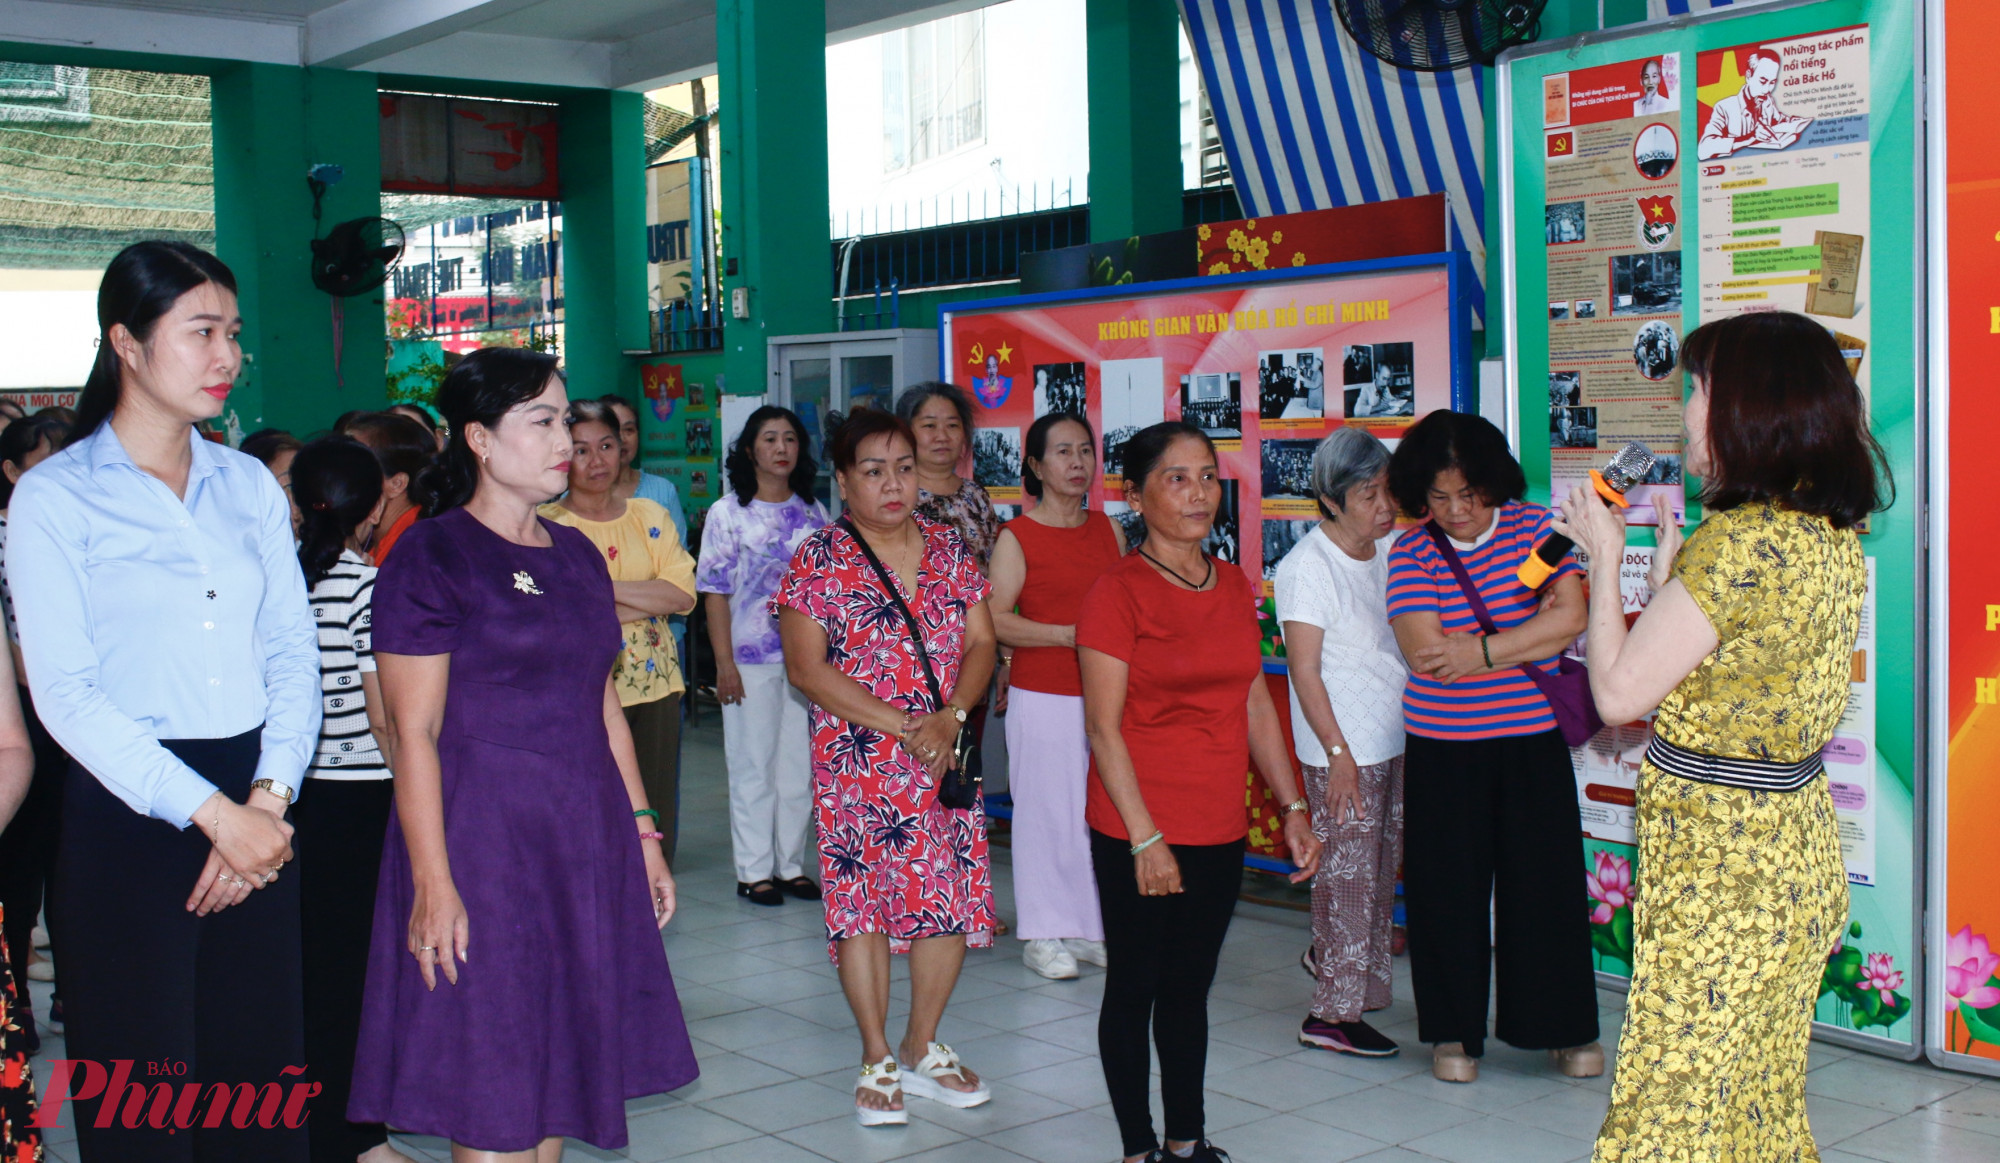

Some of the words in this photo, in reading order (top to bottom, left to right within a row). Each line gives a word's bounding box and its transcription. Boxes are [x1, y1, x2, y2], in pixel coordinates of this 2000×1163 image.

[1783, 44, 1816, 56] Những
[1818, 40, 1833, 50] tác
[1835, 34, 1864, 51] phẩm
[1783, 59, 1799, 71] nổi
[1801, 56, 1826, 68] tiếng
[1783, 76, 1800, 86] của
[1802, 72, 1820, 84] Bác
[1822, 68, 1836, 80] Hồ
[1098, 316, 1150, 340] KHÔNG
[1155, 316, 1190, 337] GIAN
[1196, 310, 1229, 332] VĂN
[1234, 306, 1269, 330] HÓA
[1275, 300, 1298, 328] HỒ
[1304, 301, 1335, 325] CHÍ
[1341, 300, 1390, 322] MINH
[1626, 552, 1649, 568] ĐỘC
